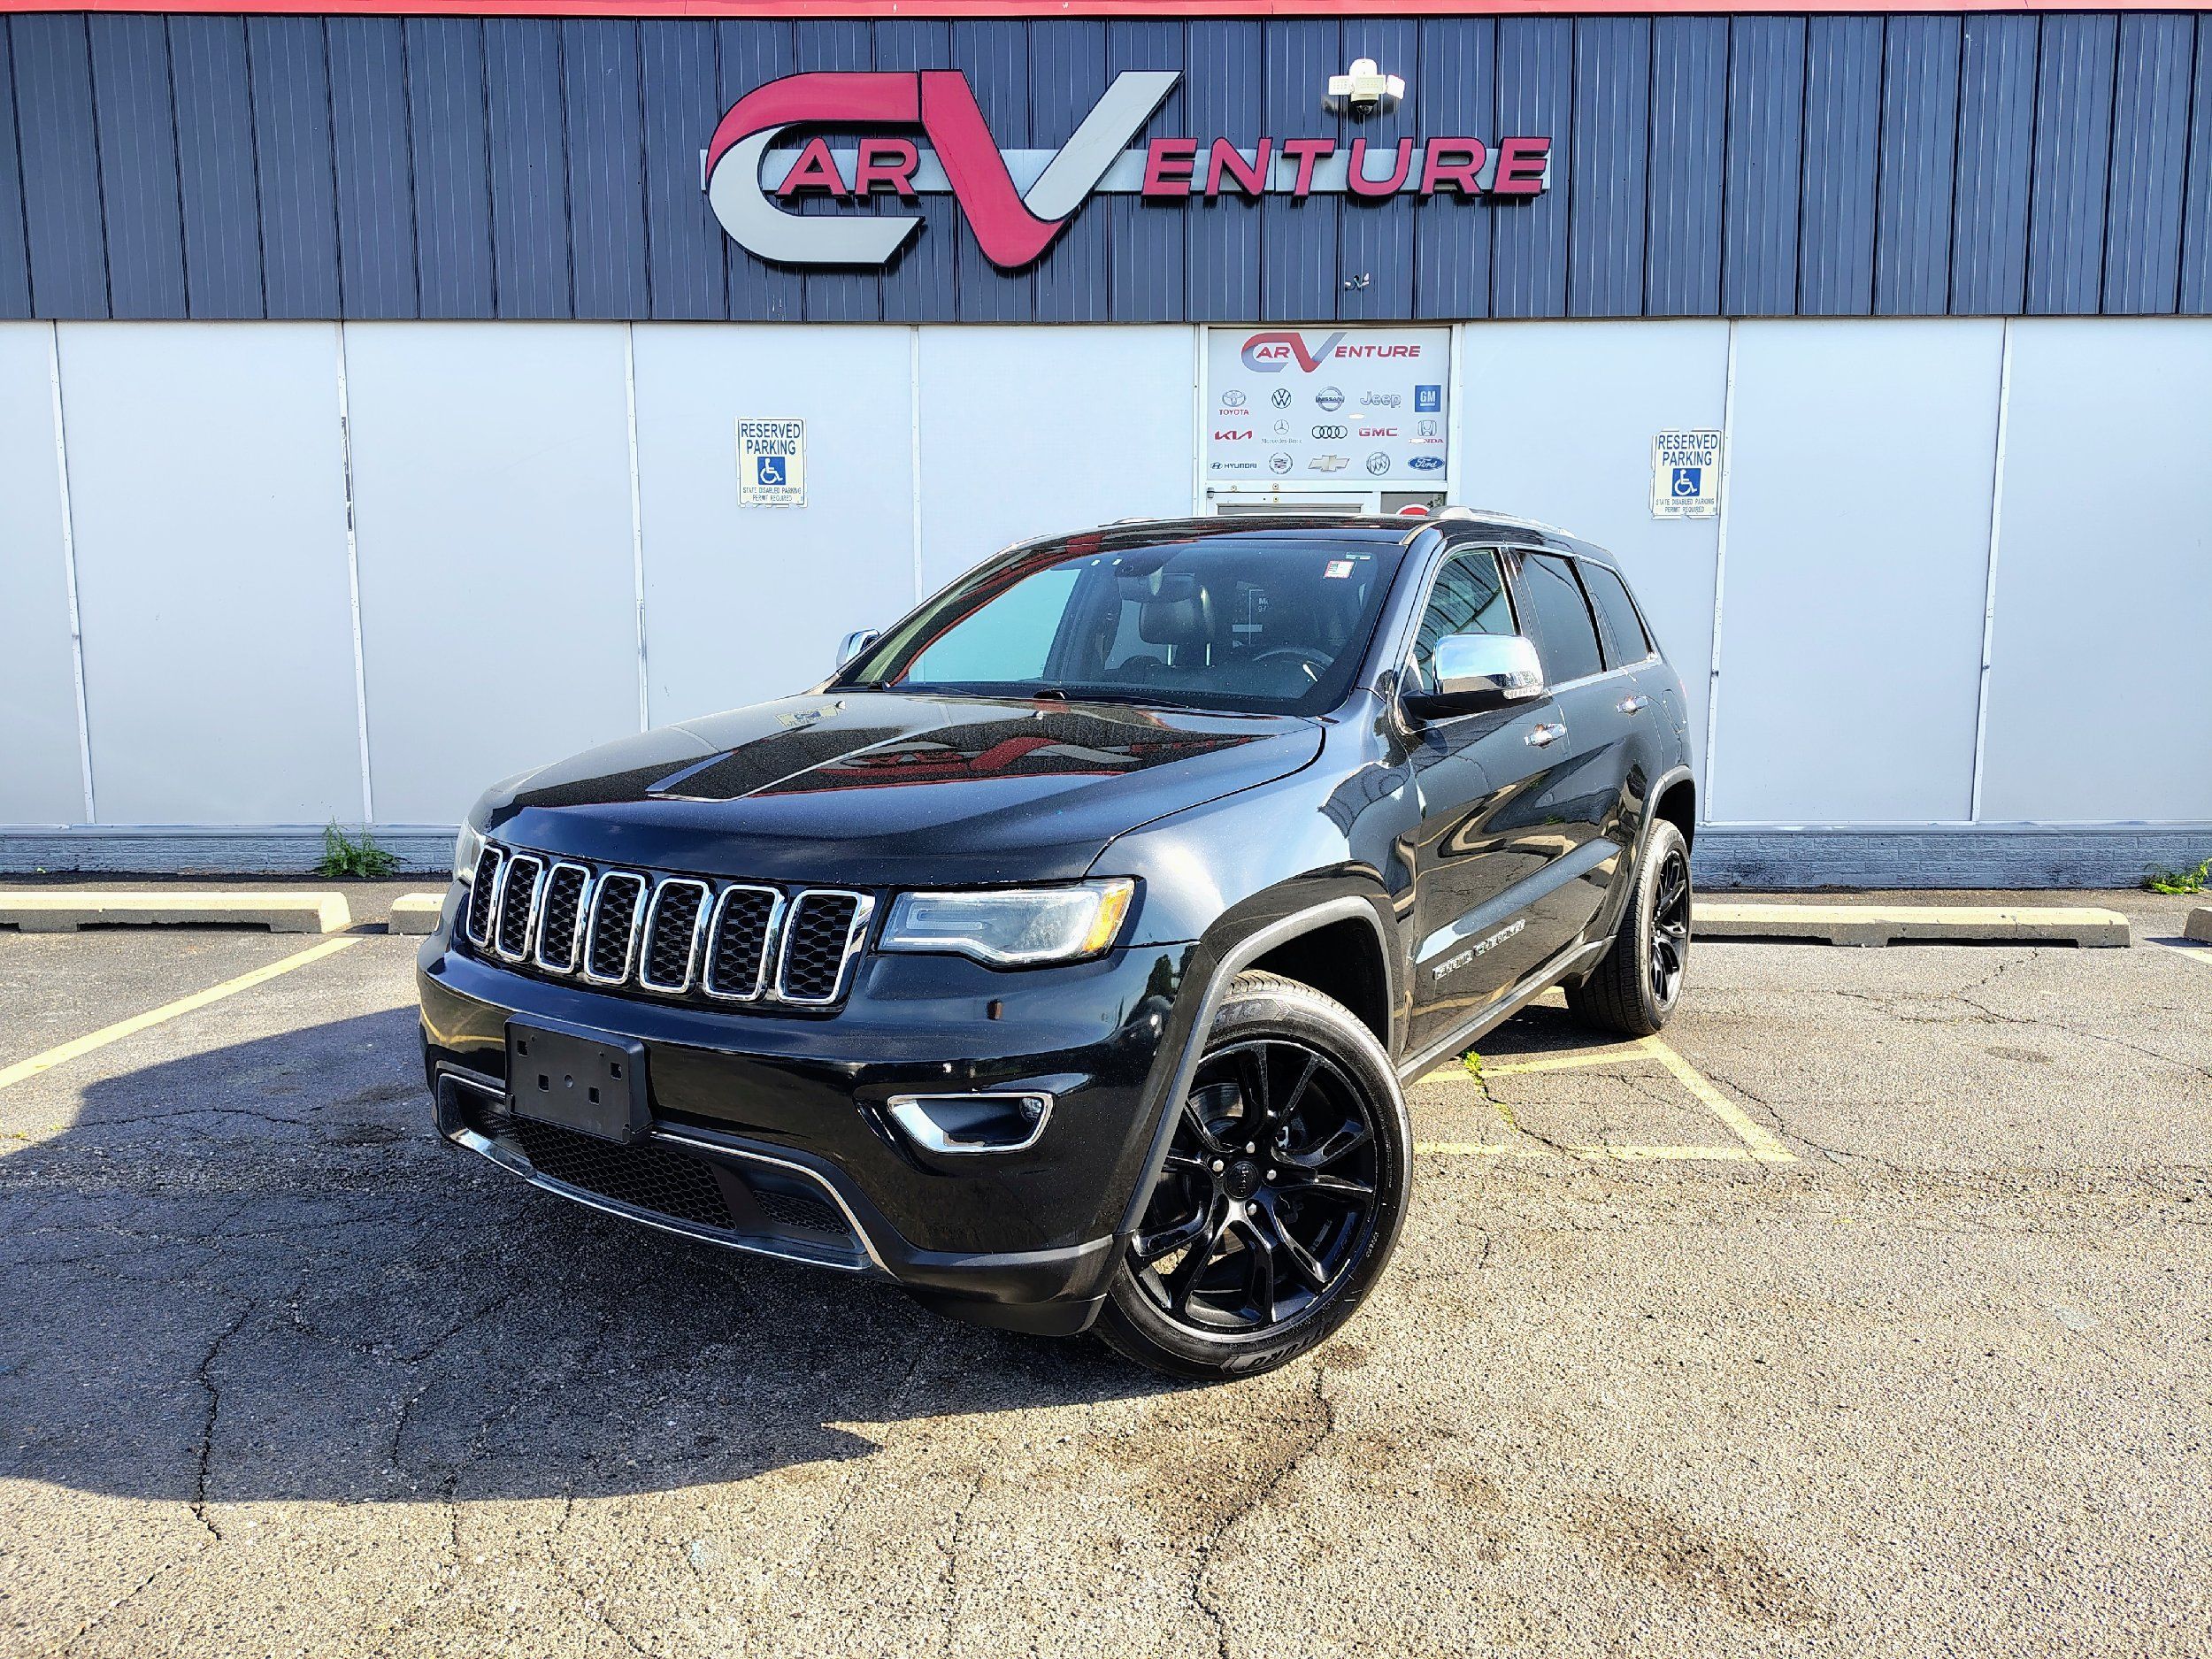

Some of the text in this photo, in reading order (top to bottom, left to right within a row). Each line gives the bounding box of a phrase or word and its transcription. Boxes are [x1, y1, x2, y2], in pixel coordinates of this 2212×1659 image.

[1360, 391, 1402, 408] Jeep
[1419, 390, 1436, 403] GM
[741, 423, 801, 439] RESERVED
[1214, 430, 1253, 441] KIA
[1358, 427, 1399, 437] GMC
[746, 439, 796, 455] PARKING
[1657, 434, 1718, 449] RESERVED
[1416, 458, 1438, 470] Ford
[1662, 450, 1712, 466] PARKING
